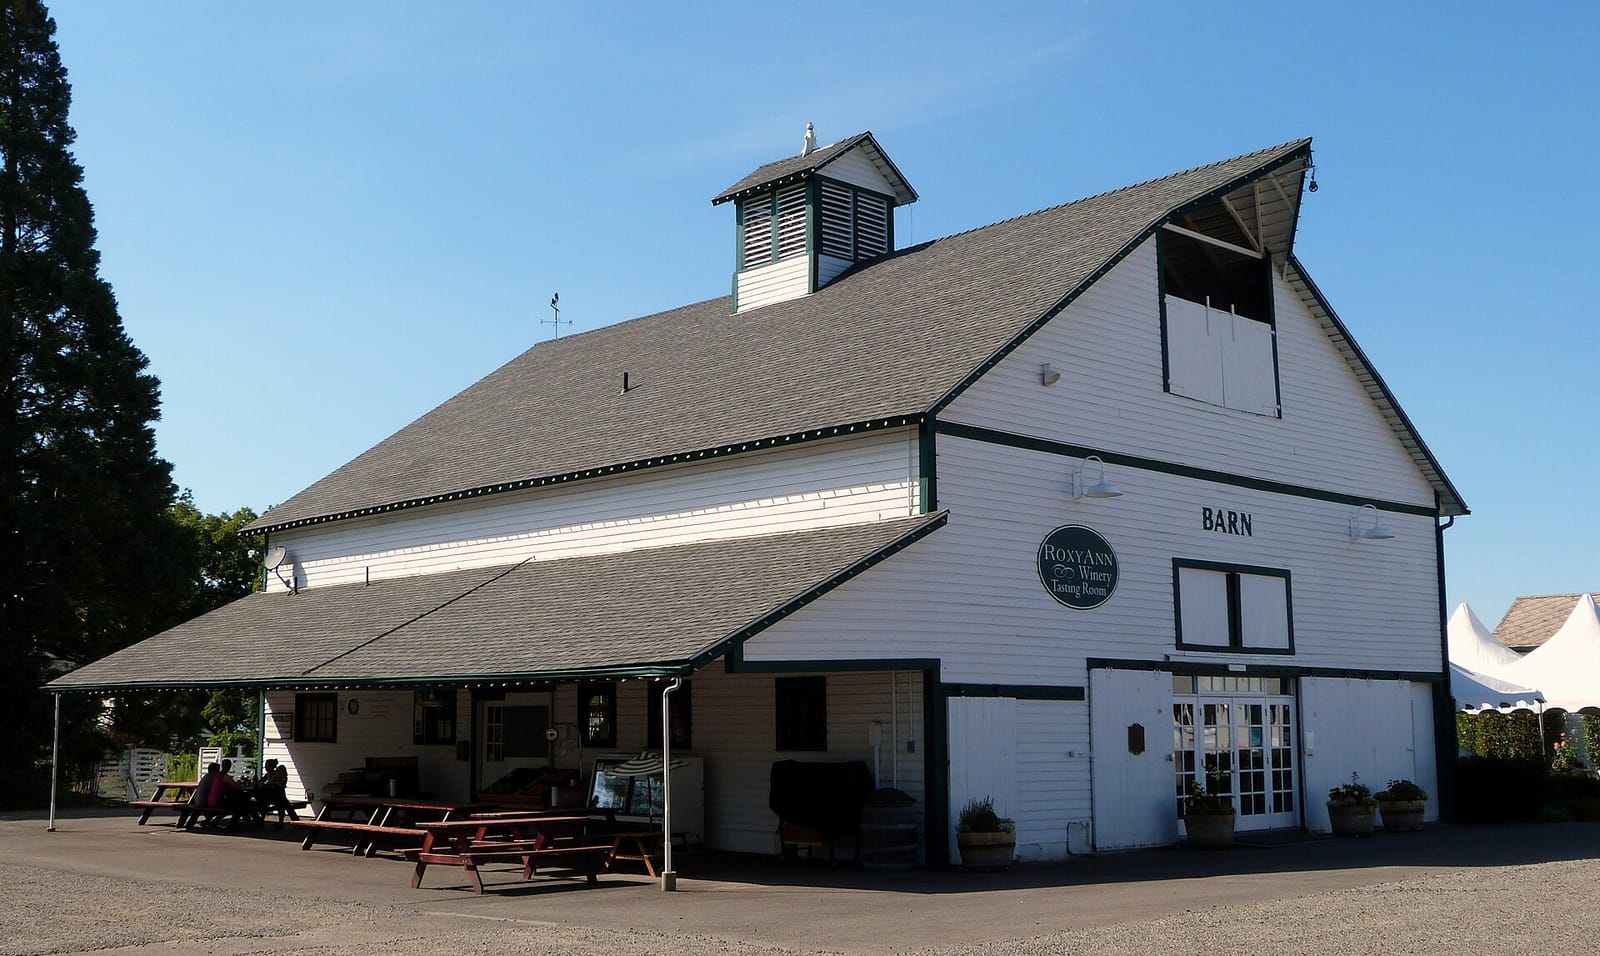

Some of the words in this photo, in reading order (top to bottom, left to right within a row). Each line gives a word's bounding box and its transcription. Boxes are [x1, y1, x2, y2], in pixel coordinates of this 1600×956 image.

[1202, 506, 1253, 537] BARN
[1079, 565, 1112, 587] Winery
[1051, 579, 1081, 598] Tasting
[1082, 581, 1107, 596] Room
